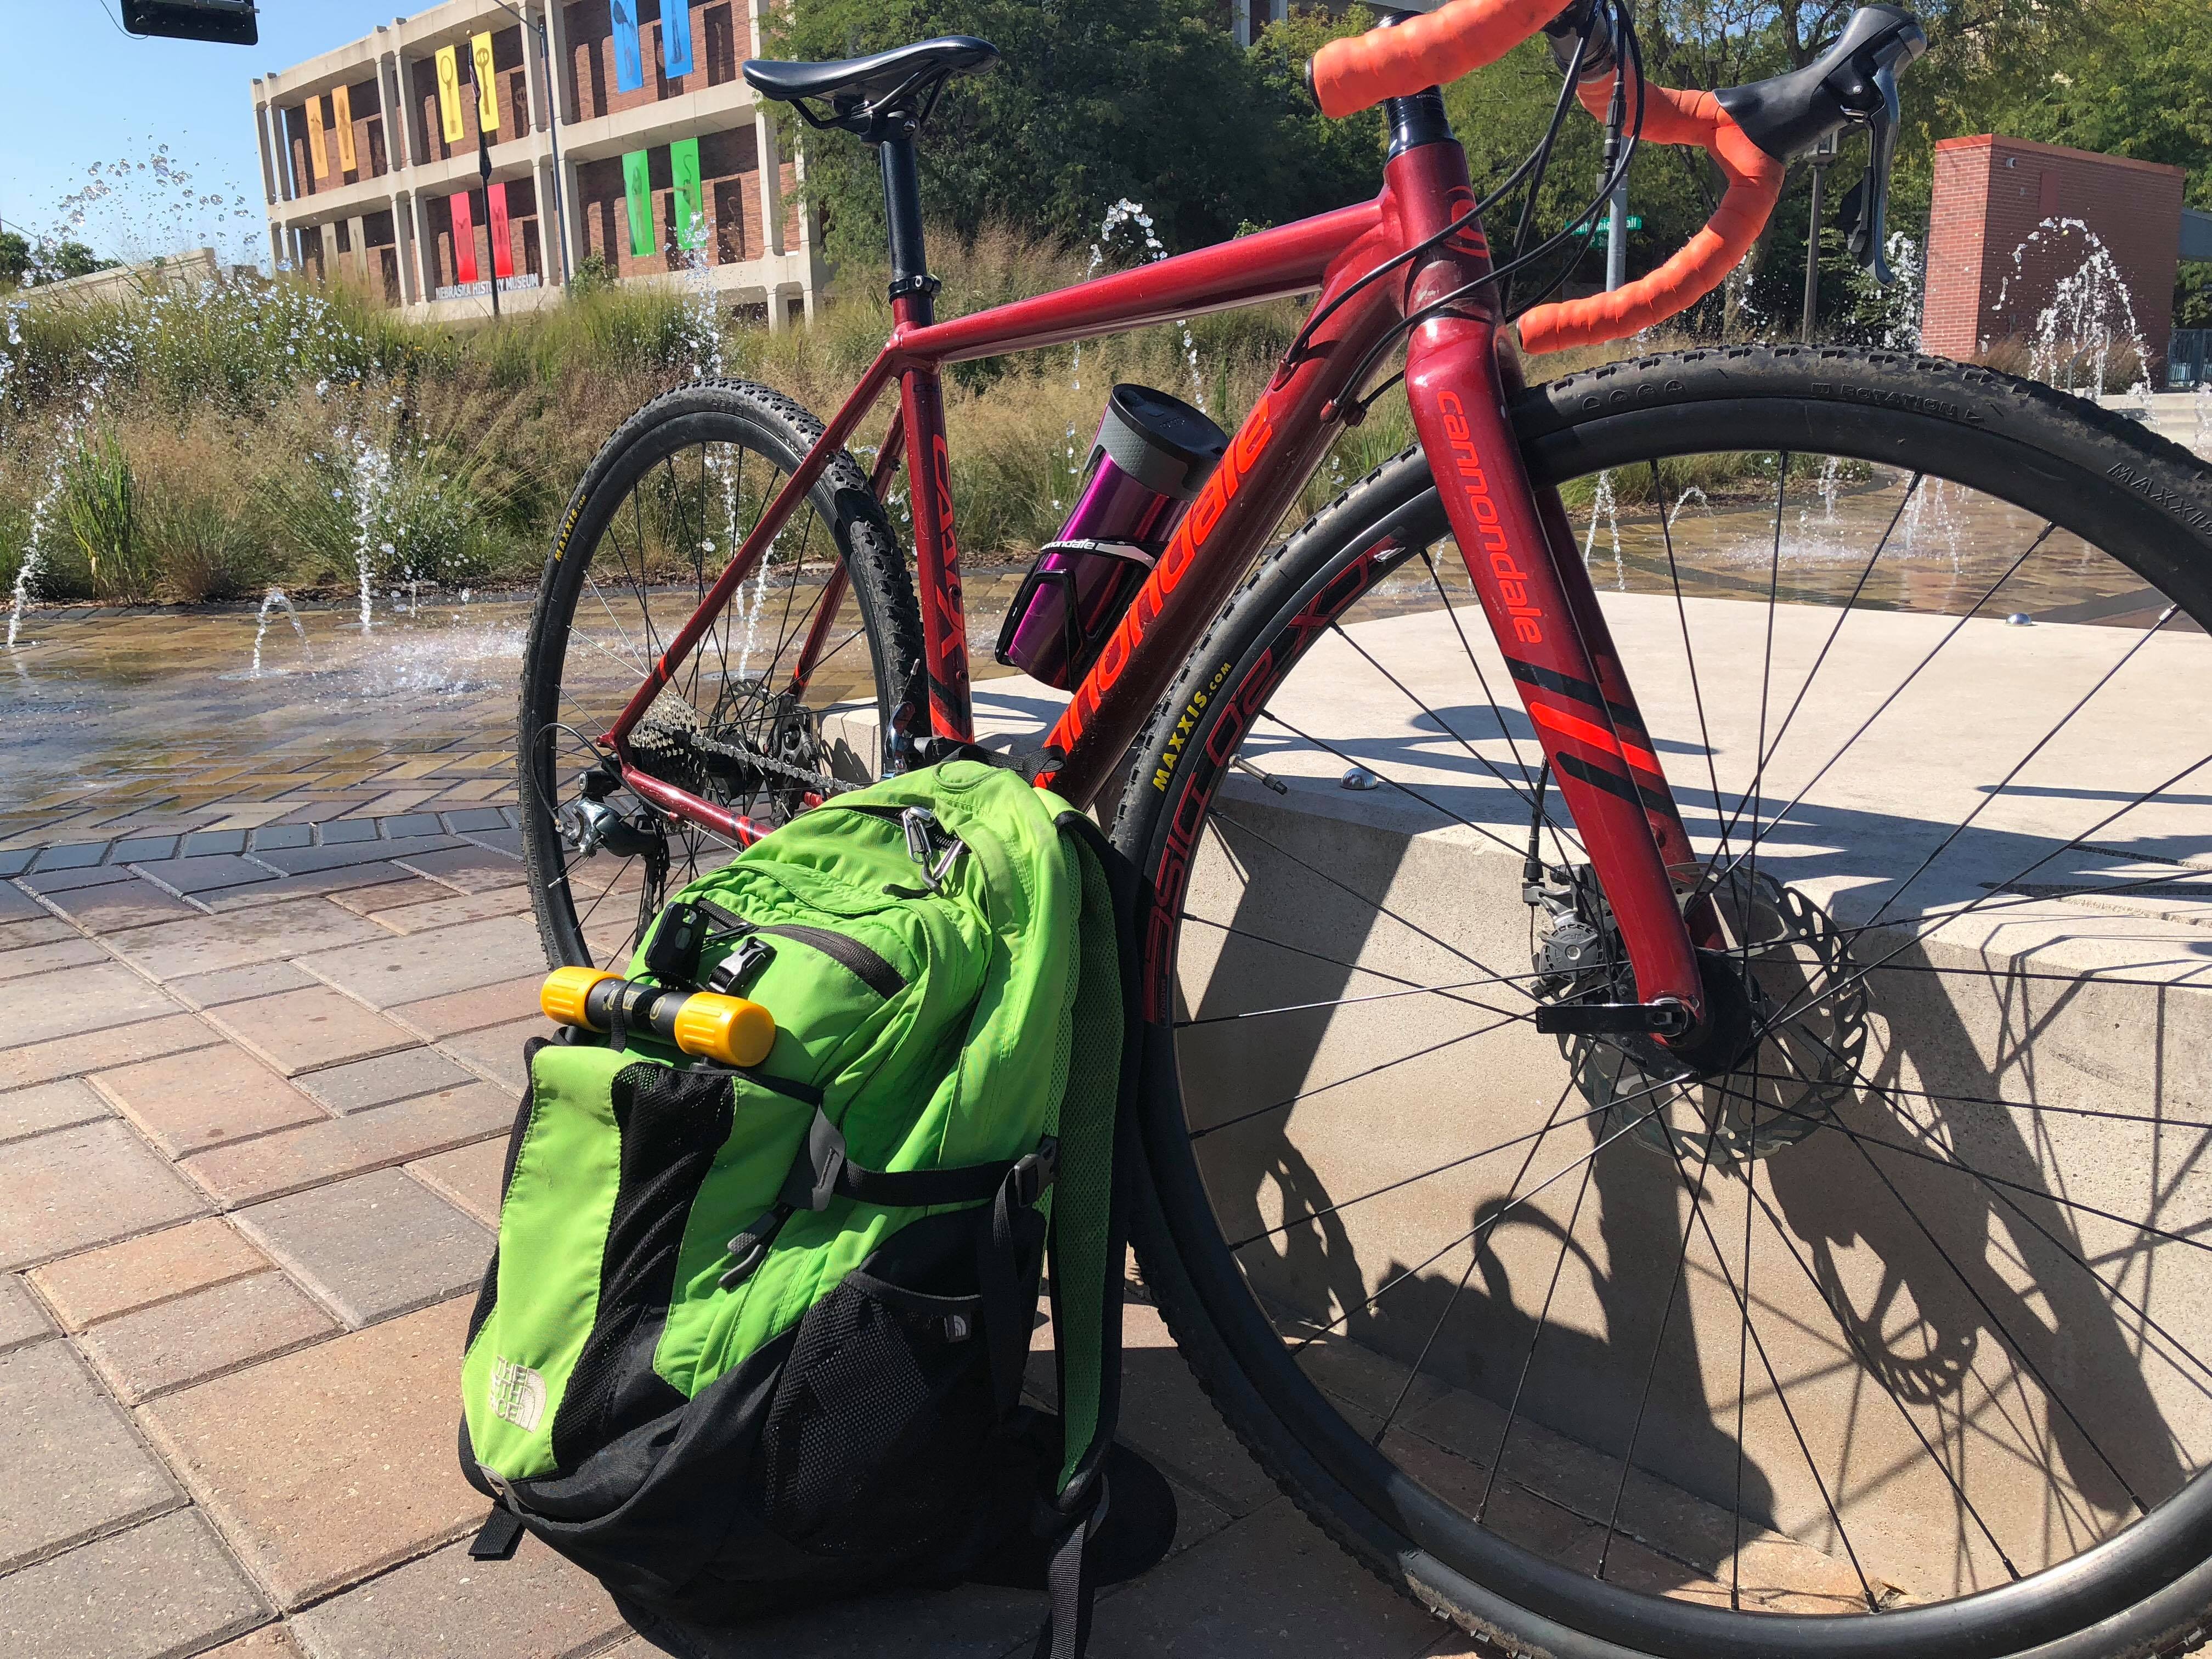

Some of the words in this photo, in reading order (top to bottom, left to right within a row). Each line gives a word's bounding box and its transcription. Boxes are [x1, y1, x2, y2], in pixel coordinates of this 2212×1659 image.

[436, 283, 471, 300] NEBRASKA
[505, 273, 539, 290] MUSEUM
[1840, 383, 1958, 416] ROTATION
[1437, 390, 1543, 644] cannondale
[1033, 391, 1276, 788] nnondale
[496, 1355, 528, 1385] THE
